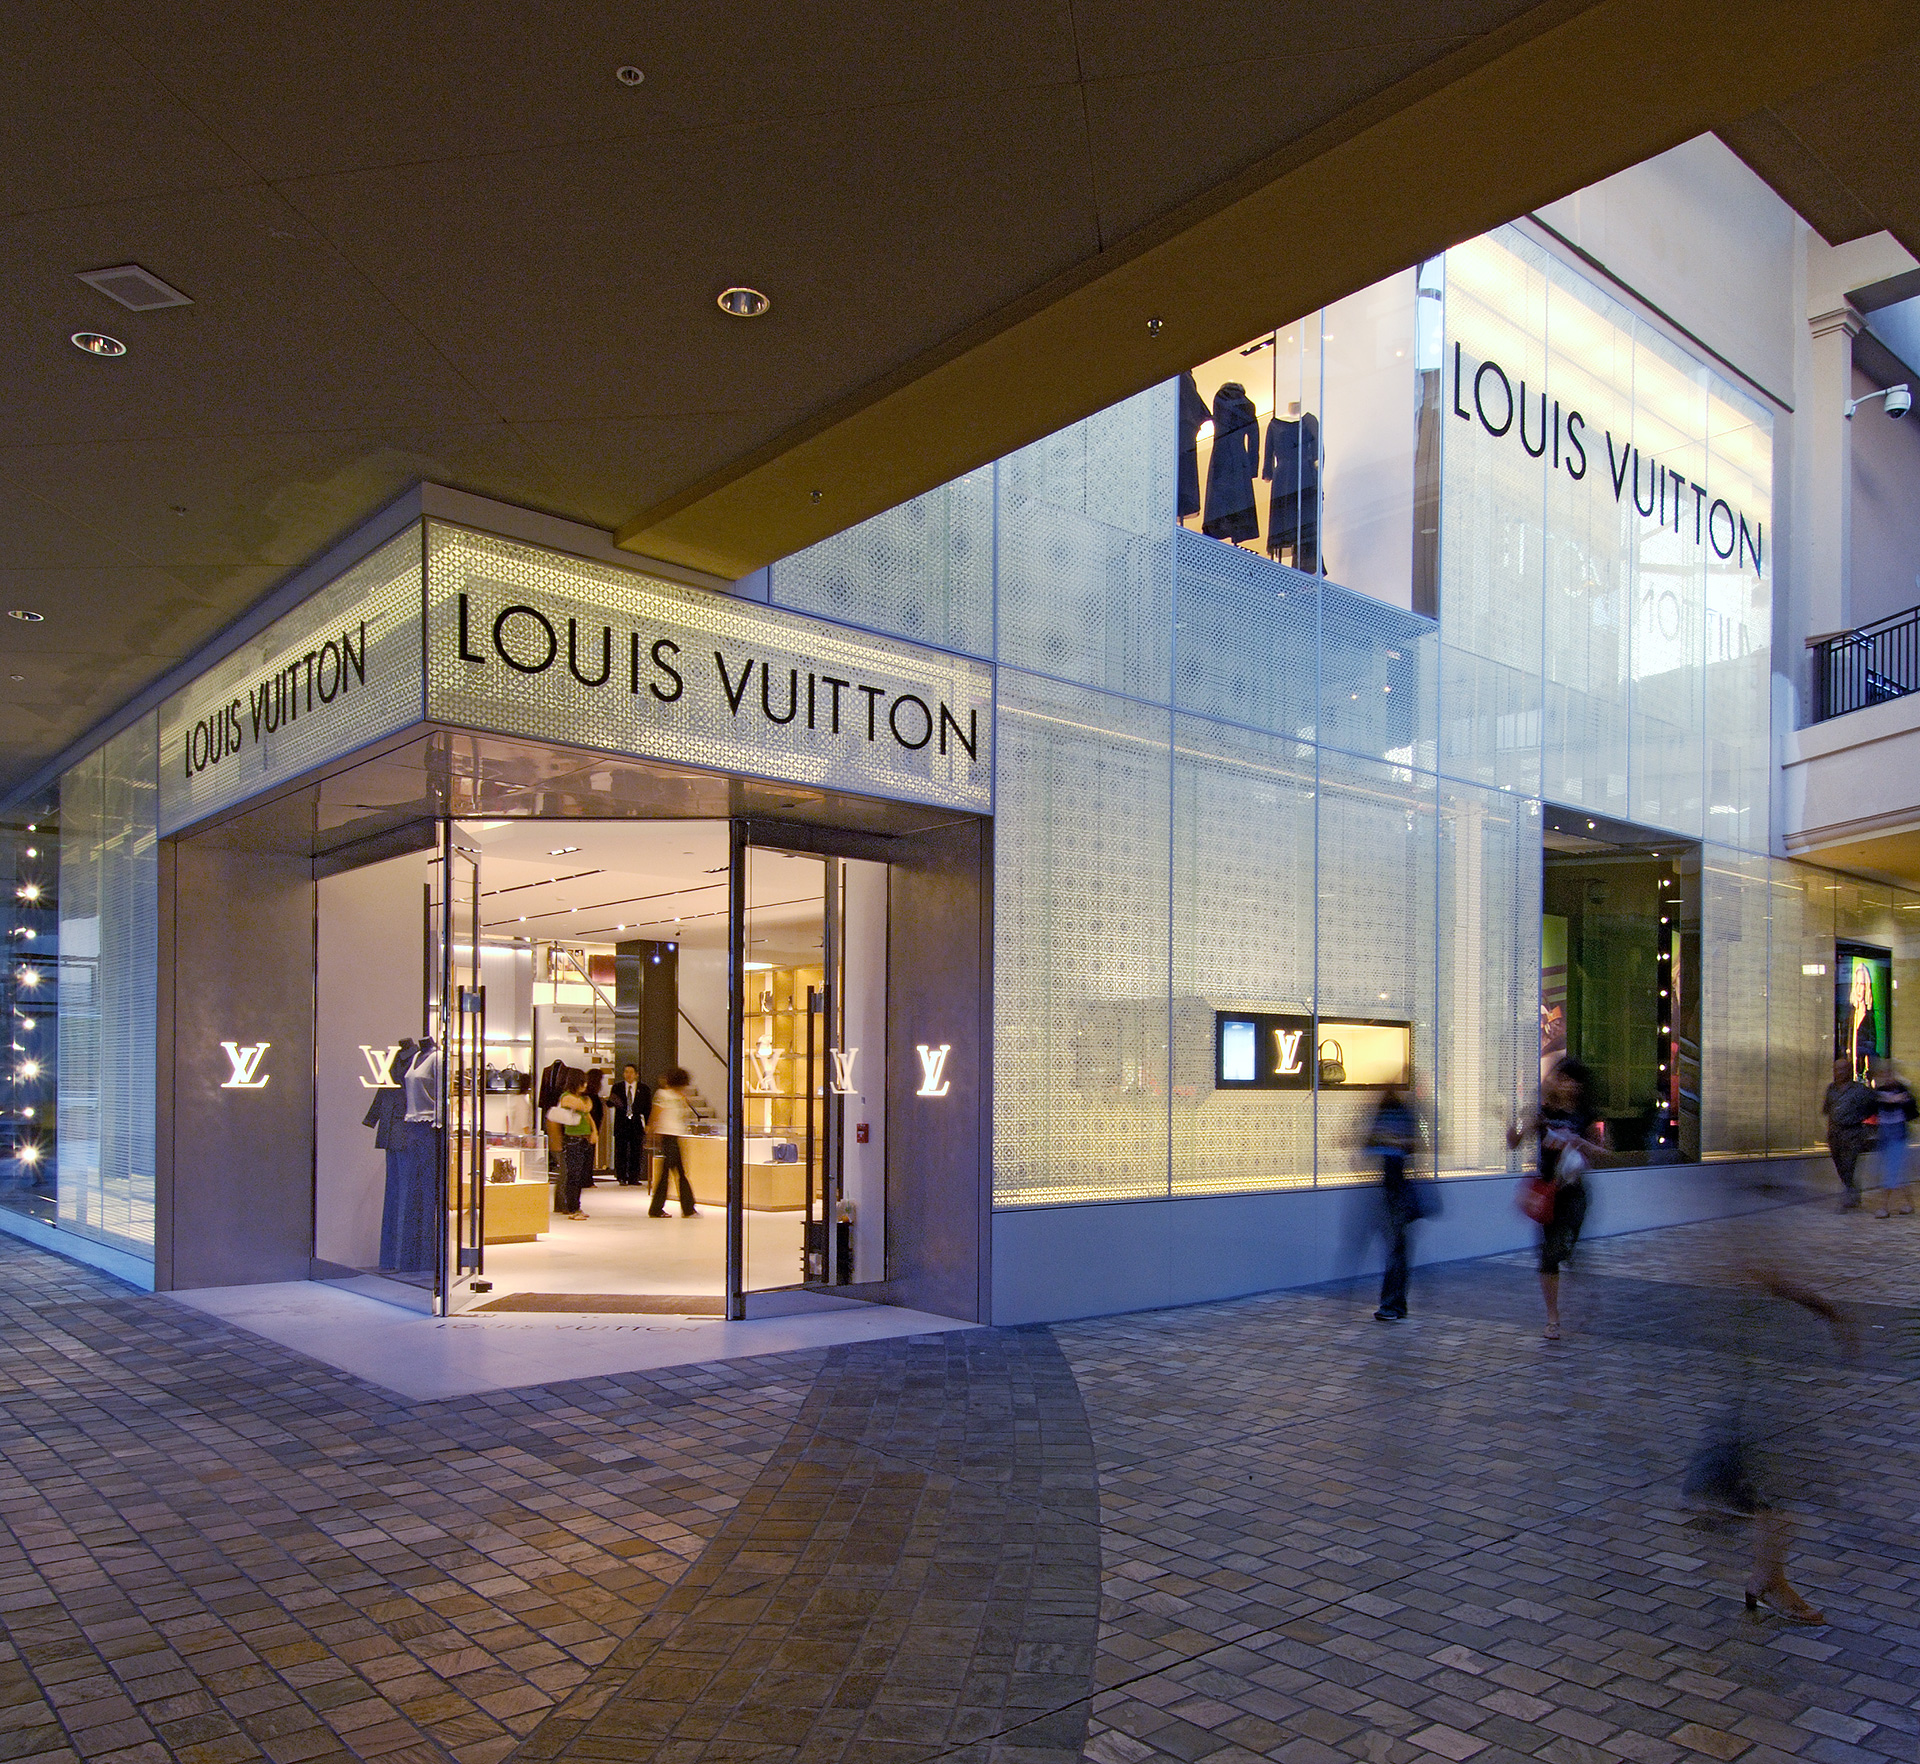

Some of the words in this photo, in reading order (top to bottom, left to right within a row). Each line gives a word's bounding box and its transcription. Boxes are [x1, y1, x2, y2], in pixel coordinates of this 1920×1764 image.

[1454, 341, 1587, 481] LOUIS
[1605, 430, 1762, 580] VUITTON
[185, 698, 242, 779] LOUIS
[250, 620, 365, 744] VUITTON
[458, 592, 684, 703] LOUIS
[715, 650, 978, 762] VUITTON
[220, 1041, 271, 1088] LV
[916, 1045, 951, 1096] LV
[1273, 1029, 1304, 1074] LV
[555, 1324, 701, 1333] VUITTON
